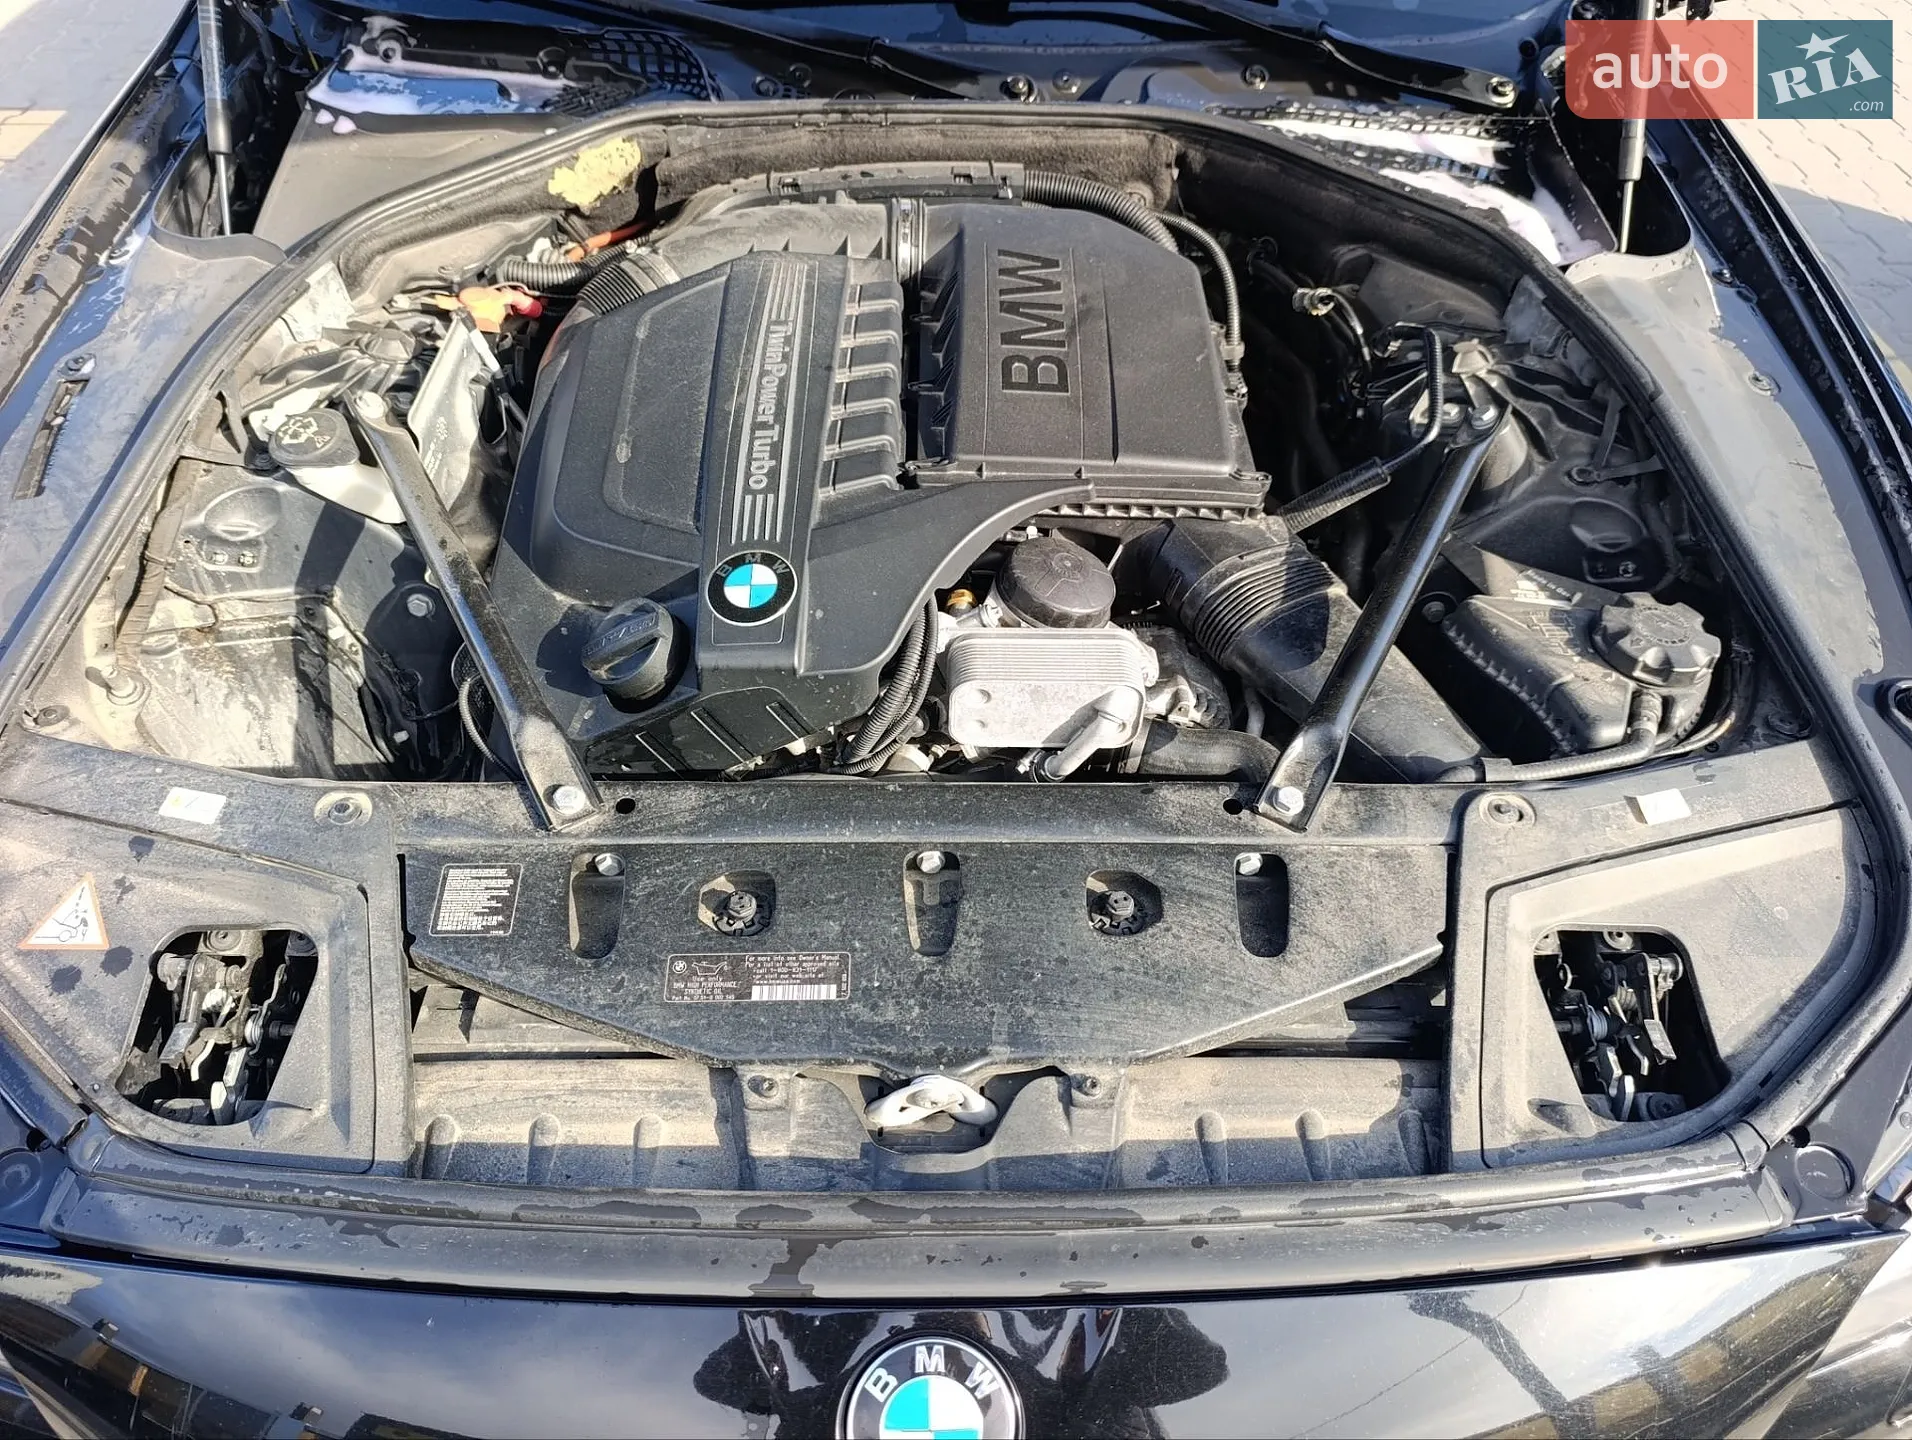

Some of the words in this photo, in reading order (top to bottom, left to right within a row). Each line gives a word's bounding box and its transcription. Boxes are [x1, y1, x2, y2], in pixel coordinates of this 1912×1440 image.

[997, 248, 1070, 395] BMW
[755, 319, 794, 426] TwinPower
[748, 423, 780, 490] Turbo
[716, 553, 790, 577] BMW
[864, 1345, 1000, 1403] BMW
